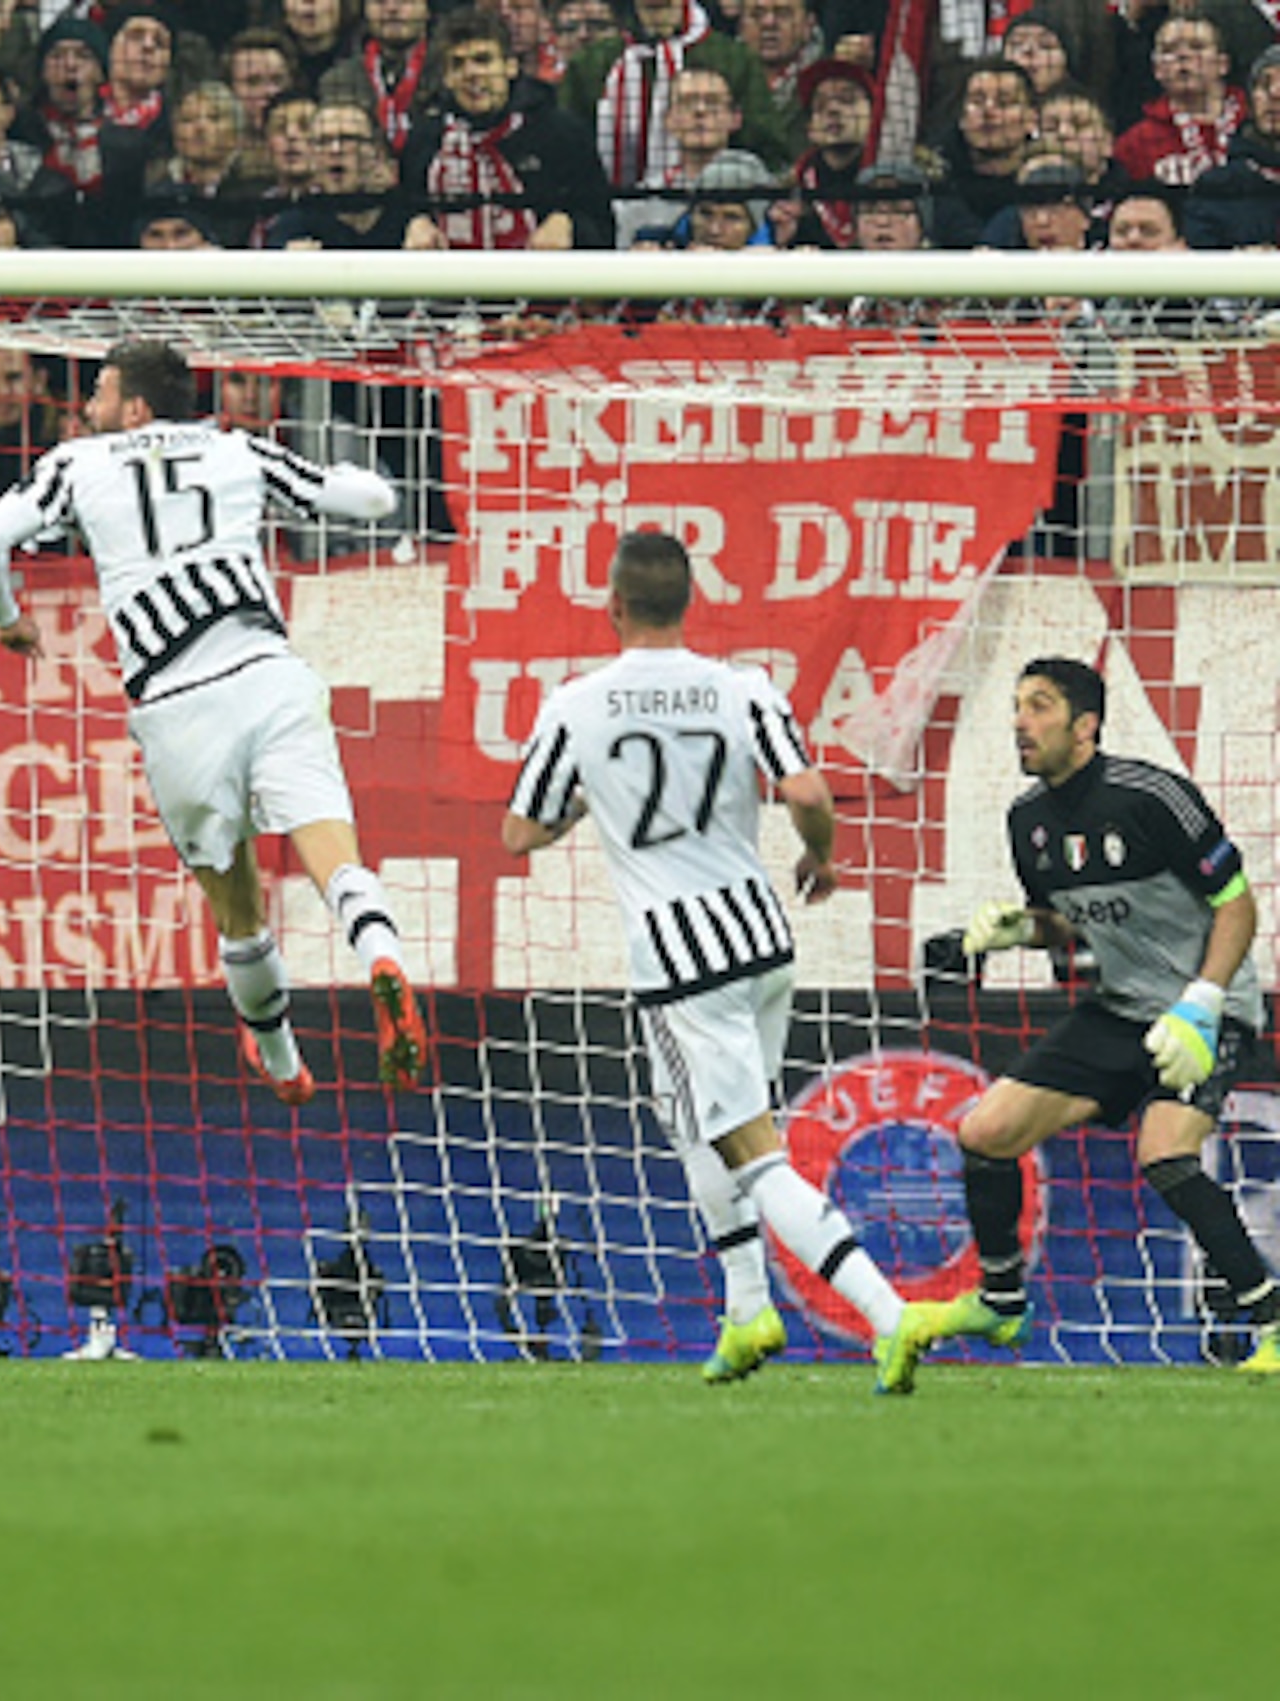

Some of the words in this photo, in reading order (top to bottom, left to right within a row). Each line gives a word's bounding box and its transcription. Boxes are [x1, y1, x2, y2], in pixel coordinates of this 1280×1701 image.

[459, 357, 1054, 472] FREIHEIT
[124, 453, 215, 557] 15
[460, 480, 743, 611] FÜR
[765, 499, 977, 600] DIE
[607, 686, 719, 718] STURARO
[607, 727, 728, 850] 27
